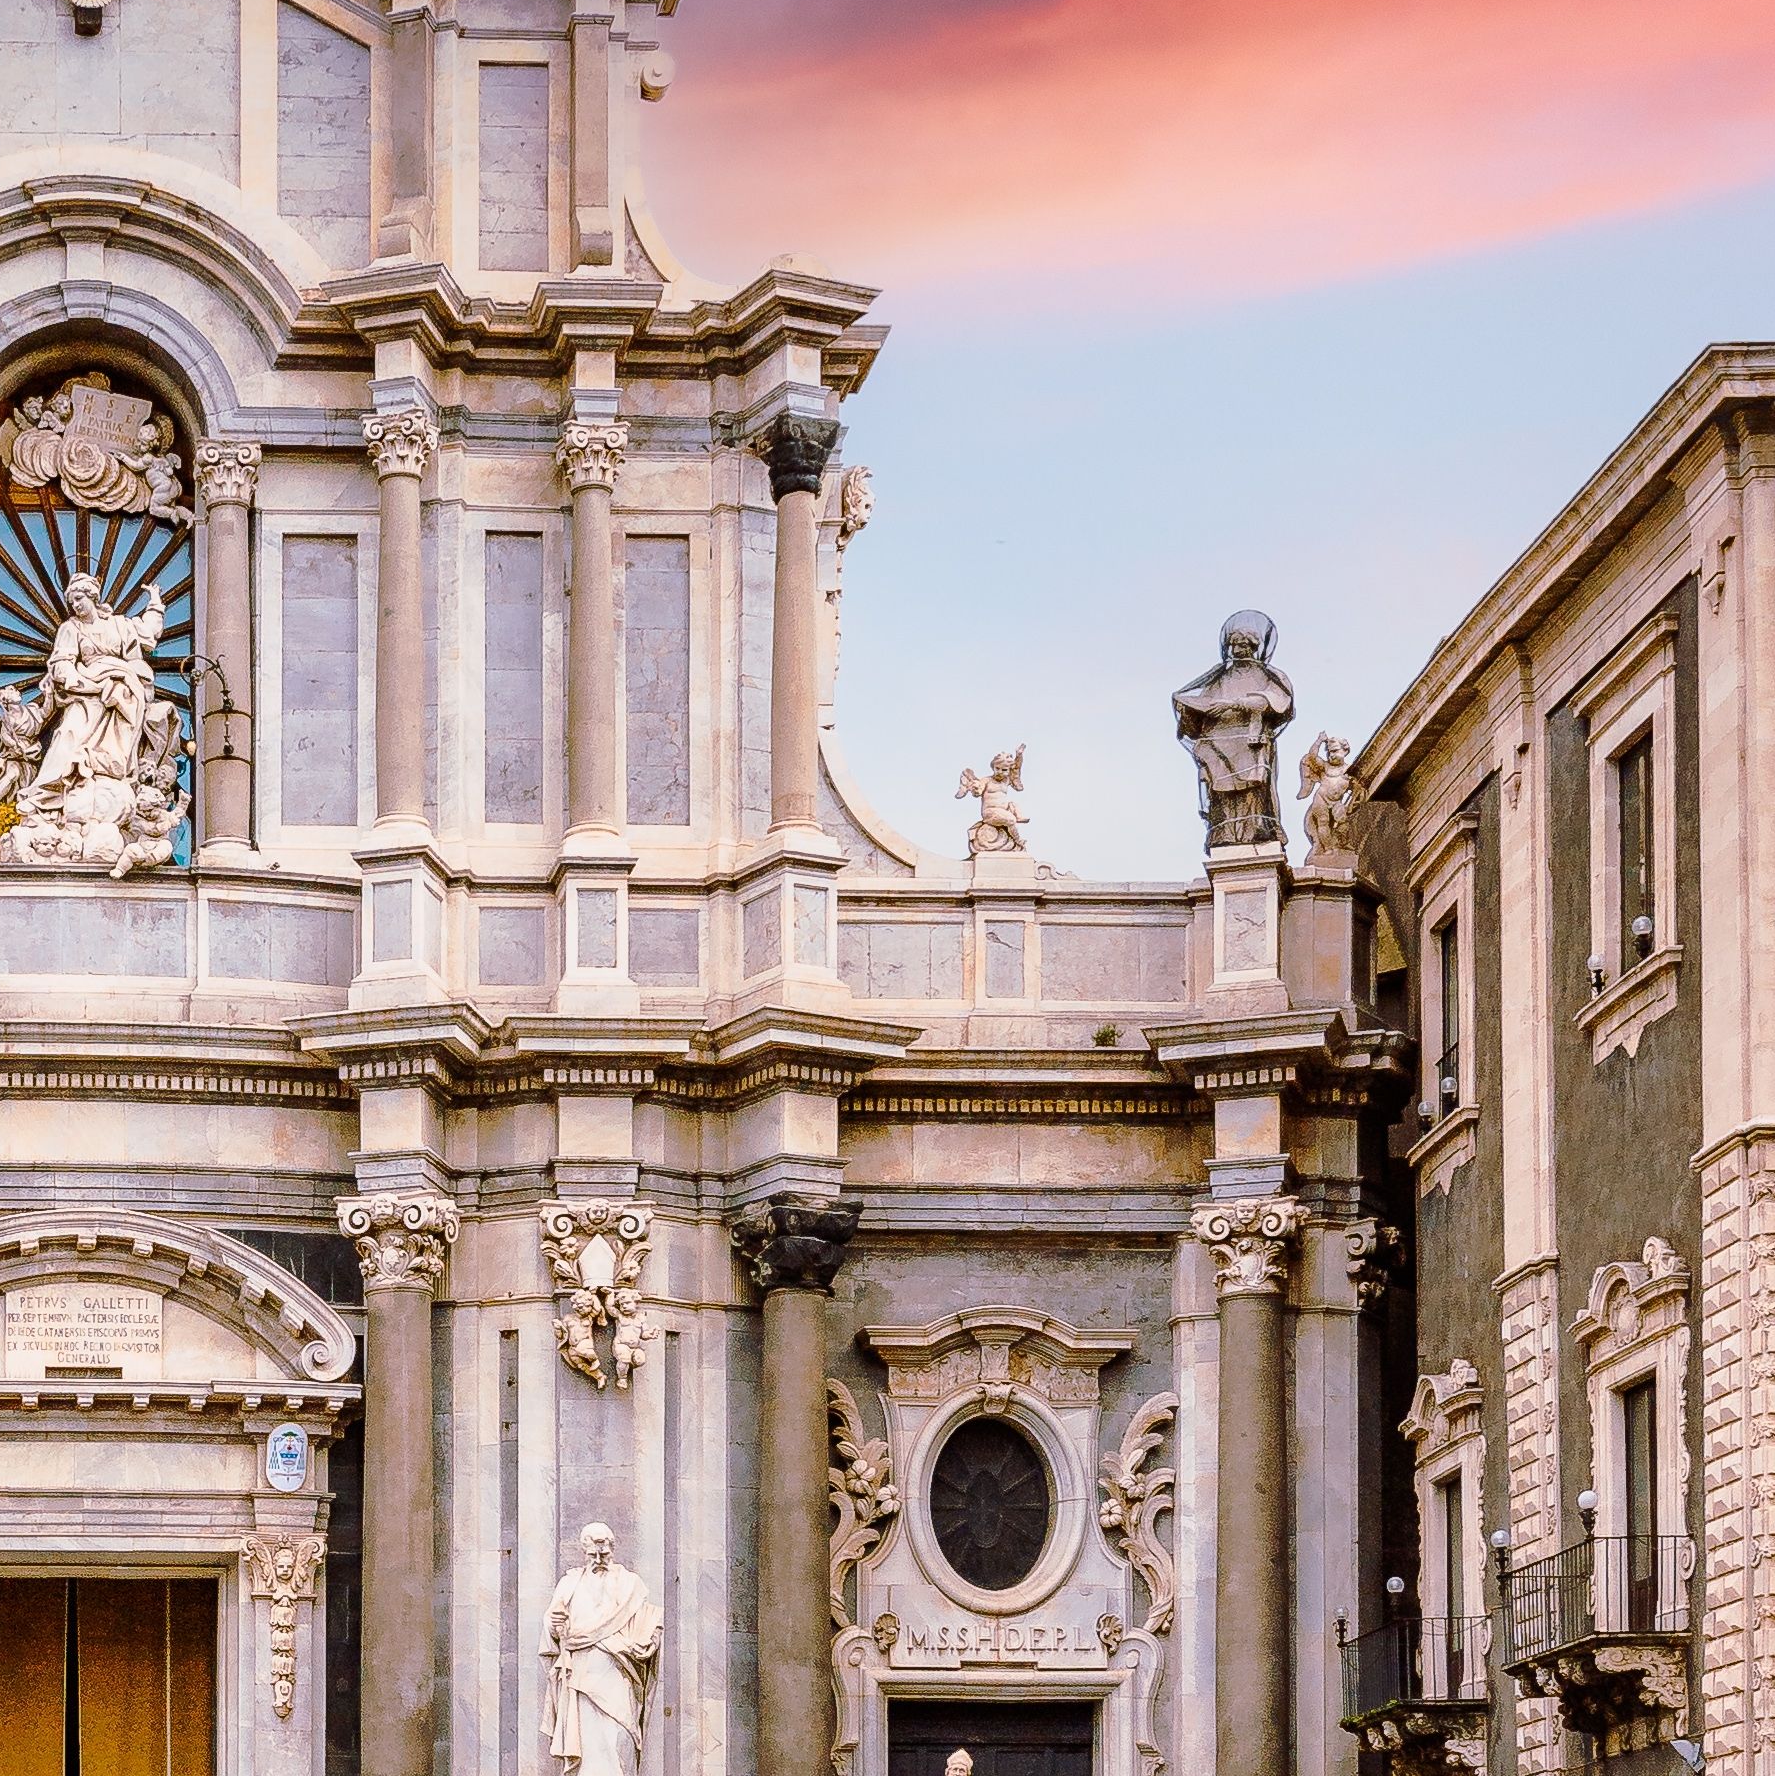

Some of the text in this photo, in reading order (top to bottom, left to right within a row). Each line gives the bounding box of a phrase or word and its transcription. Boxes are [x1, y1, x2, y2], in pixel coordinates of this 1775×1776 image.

[19, 1297, 148, 1310] PETRVS GALLETTI
[7, 1341, 18, 1351] EX
